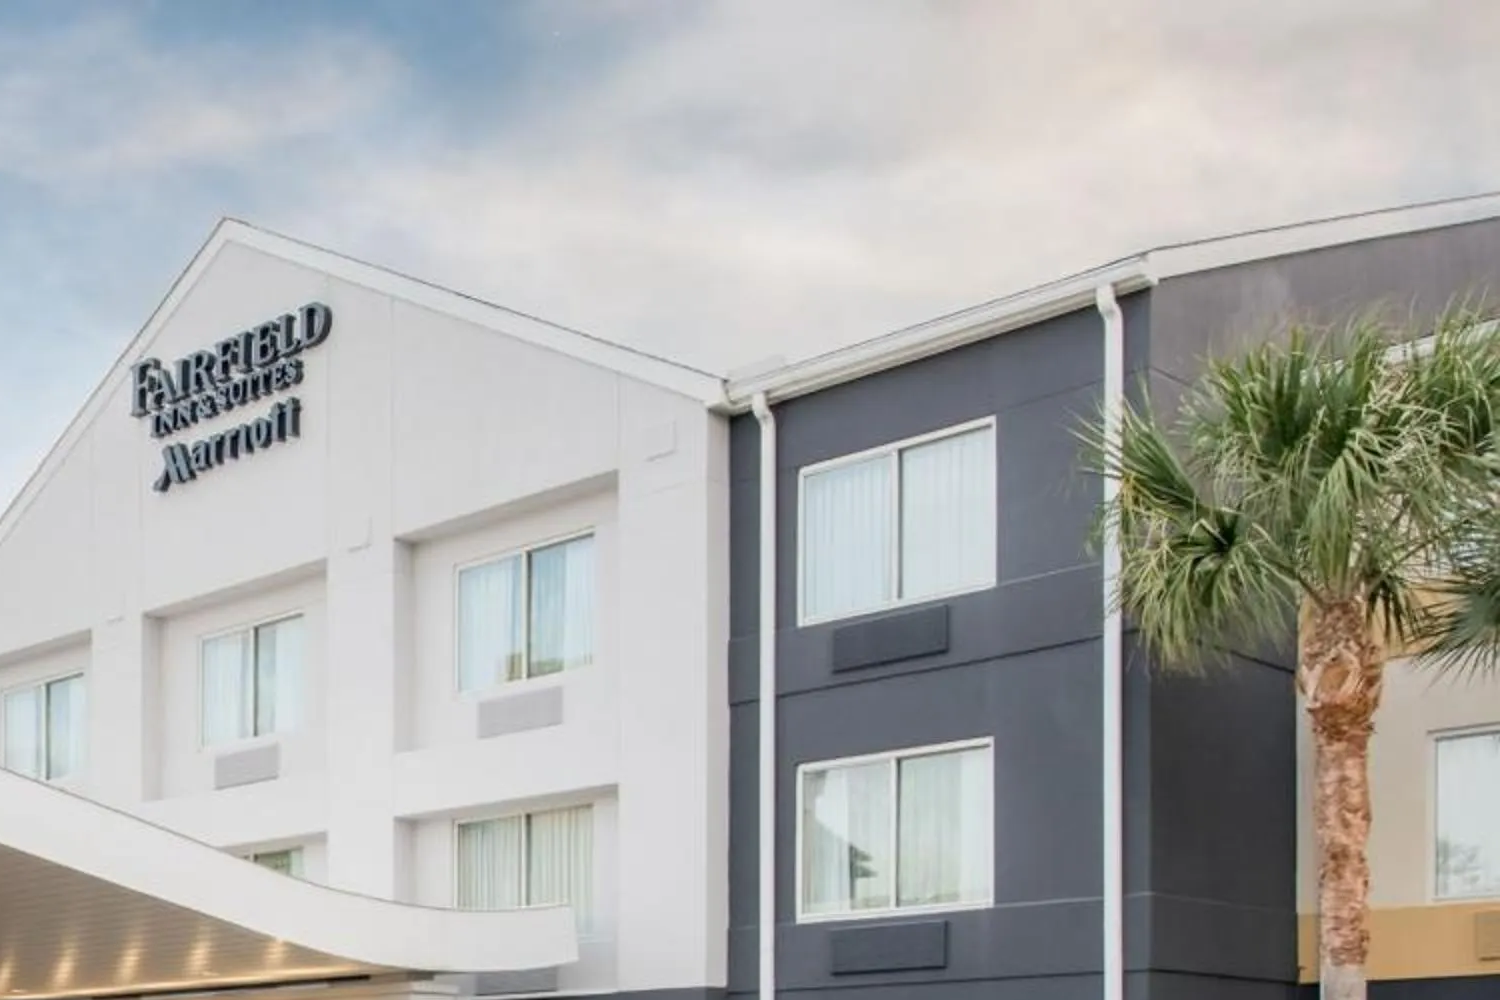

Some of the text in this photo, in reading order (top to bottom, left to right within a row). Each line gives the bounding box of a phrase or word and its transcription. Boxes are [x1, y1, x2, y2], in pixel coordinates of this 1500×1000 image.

[130, 301, 333, 418] FAIRFIELD
[151, 357, 304, 438] INN & SUITES
[153, 396, 302, 492] Marriott
